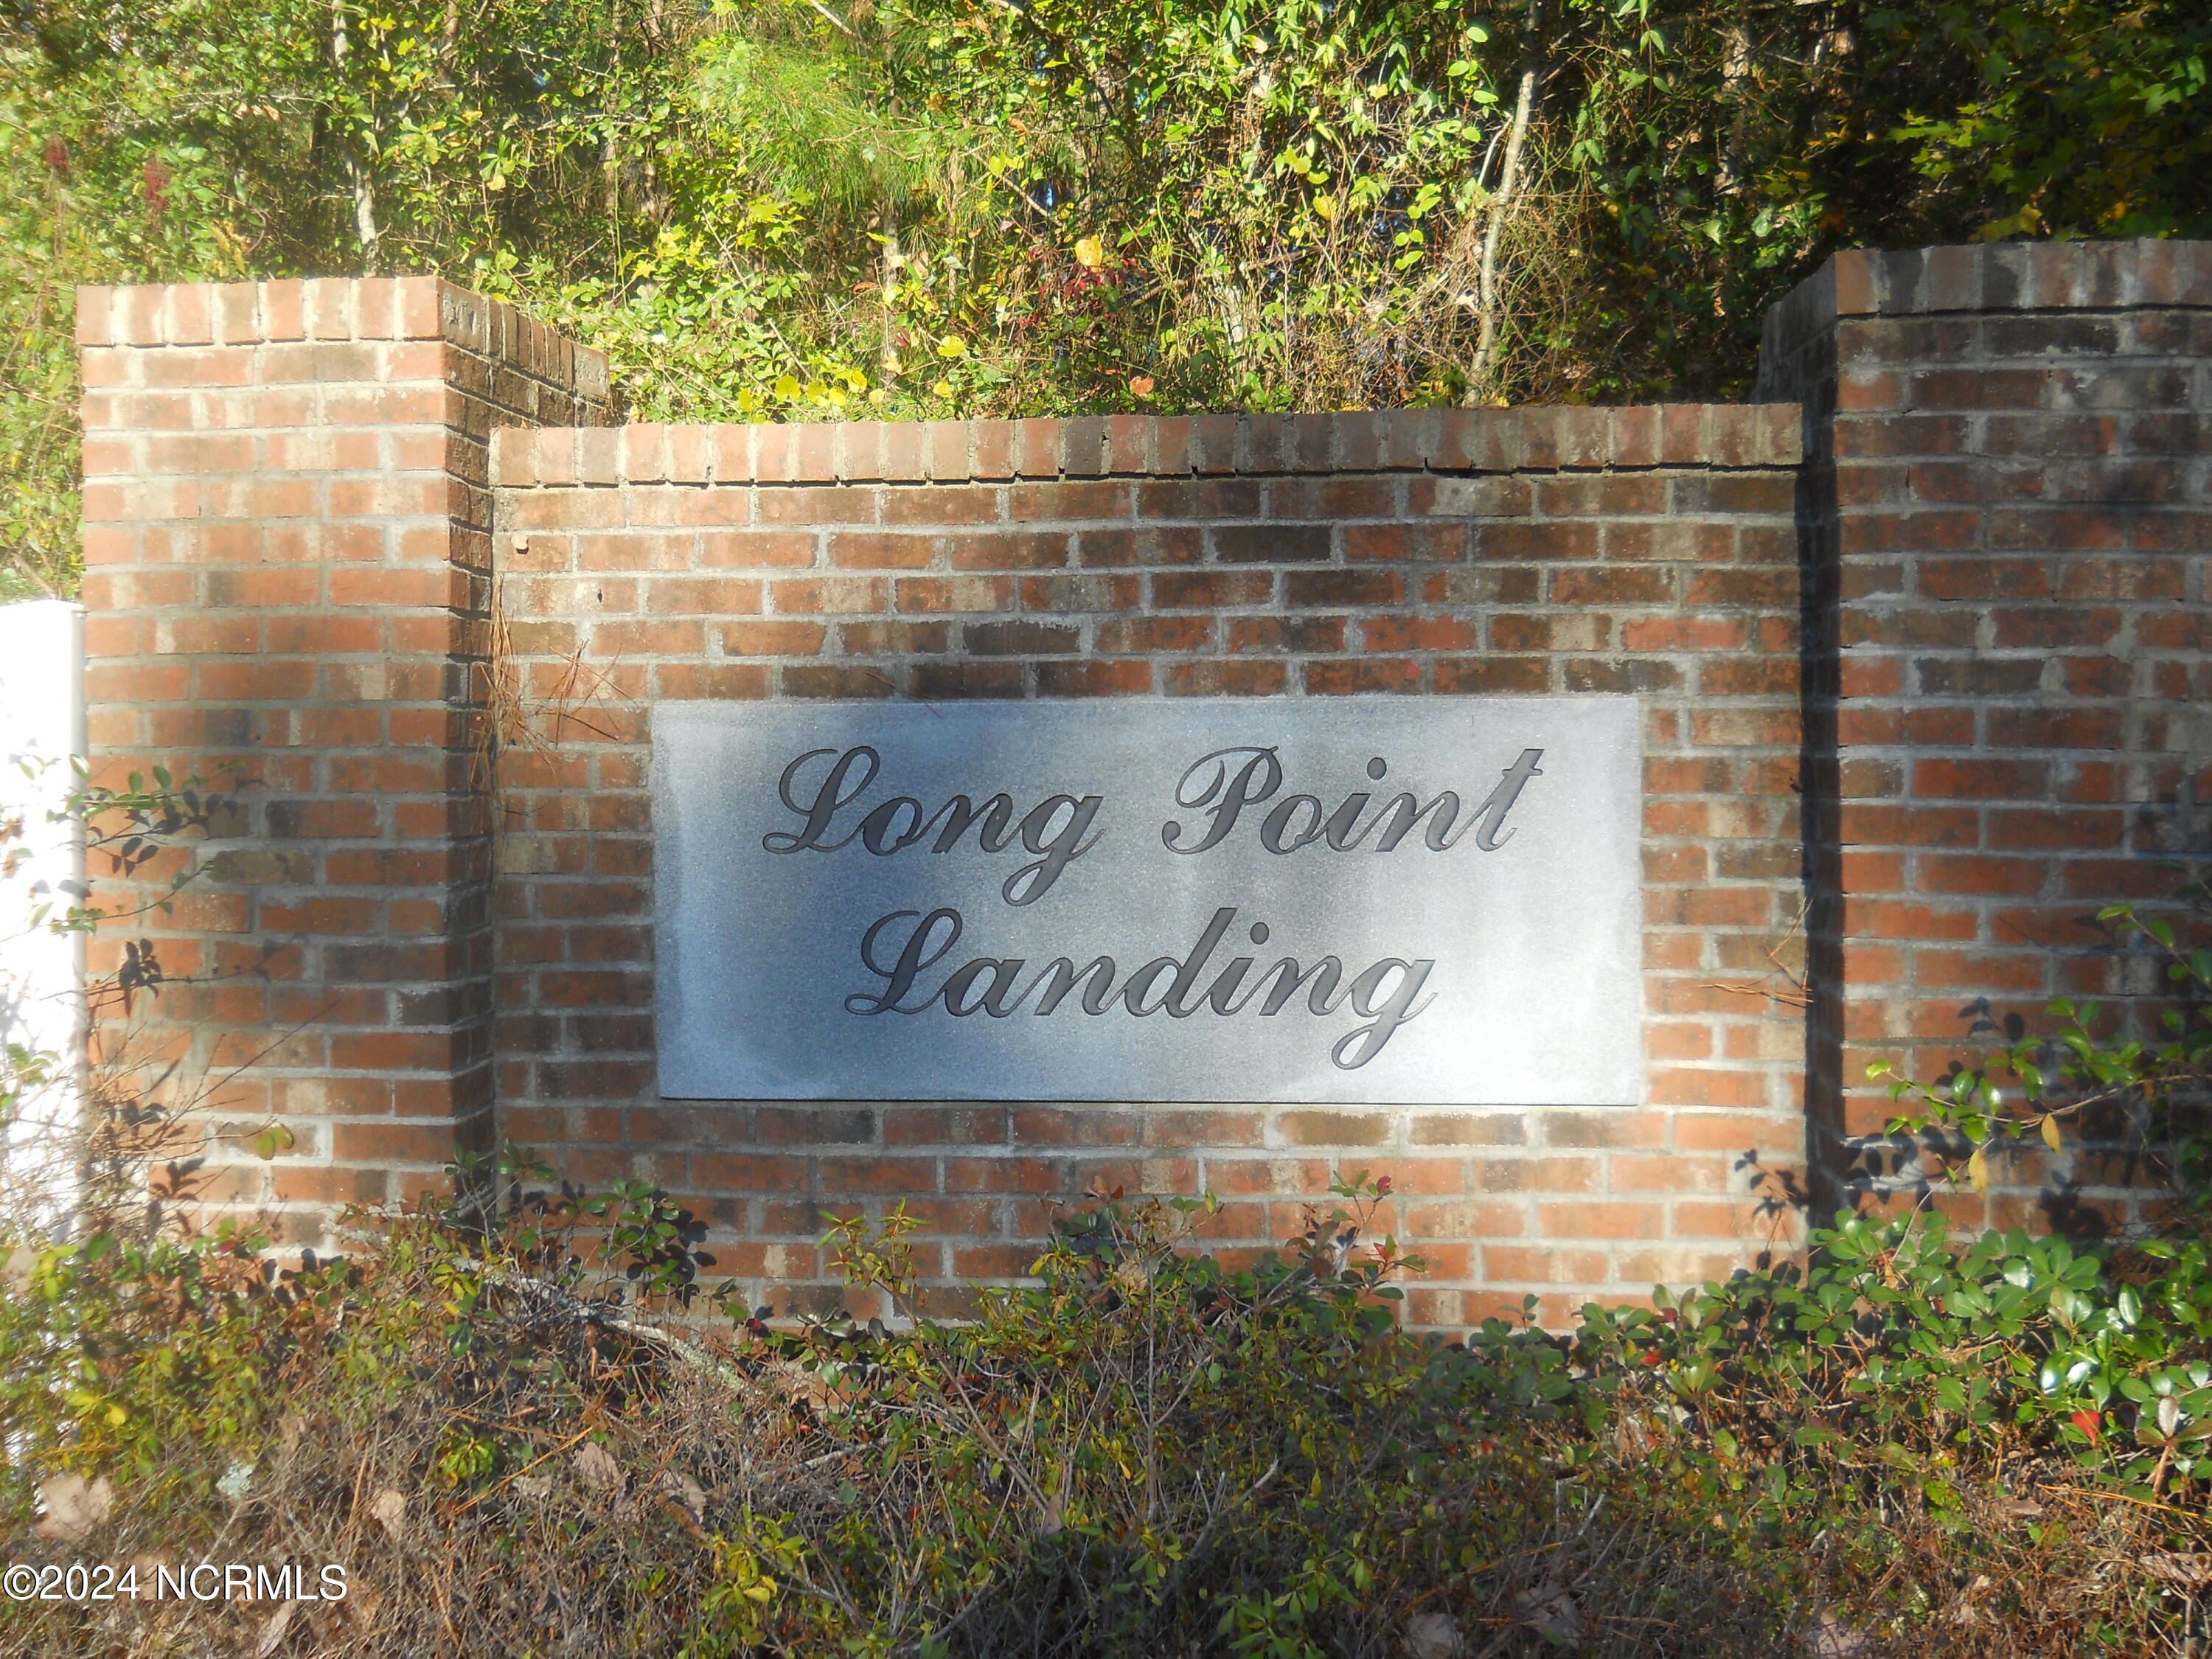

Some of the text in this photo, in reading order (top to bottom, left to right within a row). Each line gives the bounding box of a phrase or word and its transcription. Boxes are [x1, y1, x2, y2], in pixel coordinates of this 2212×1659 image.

[762, 745, 1544, 907] Long Point
[845, 907, 1436, 1070] Landing
